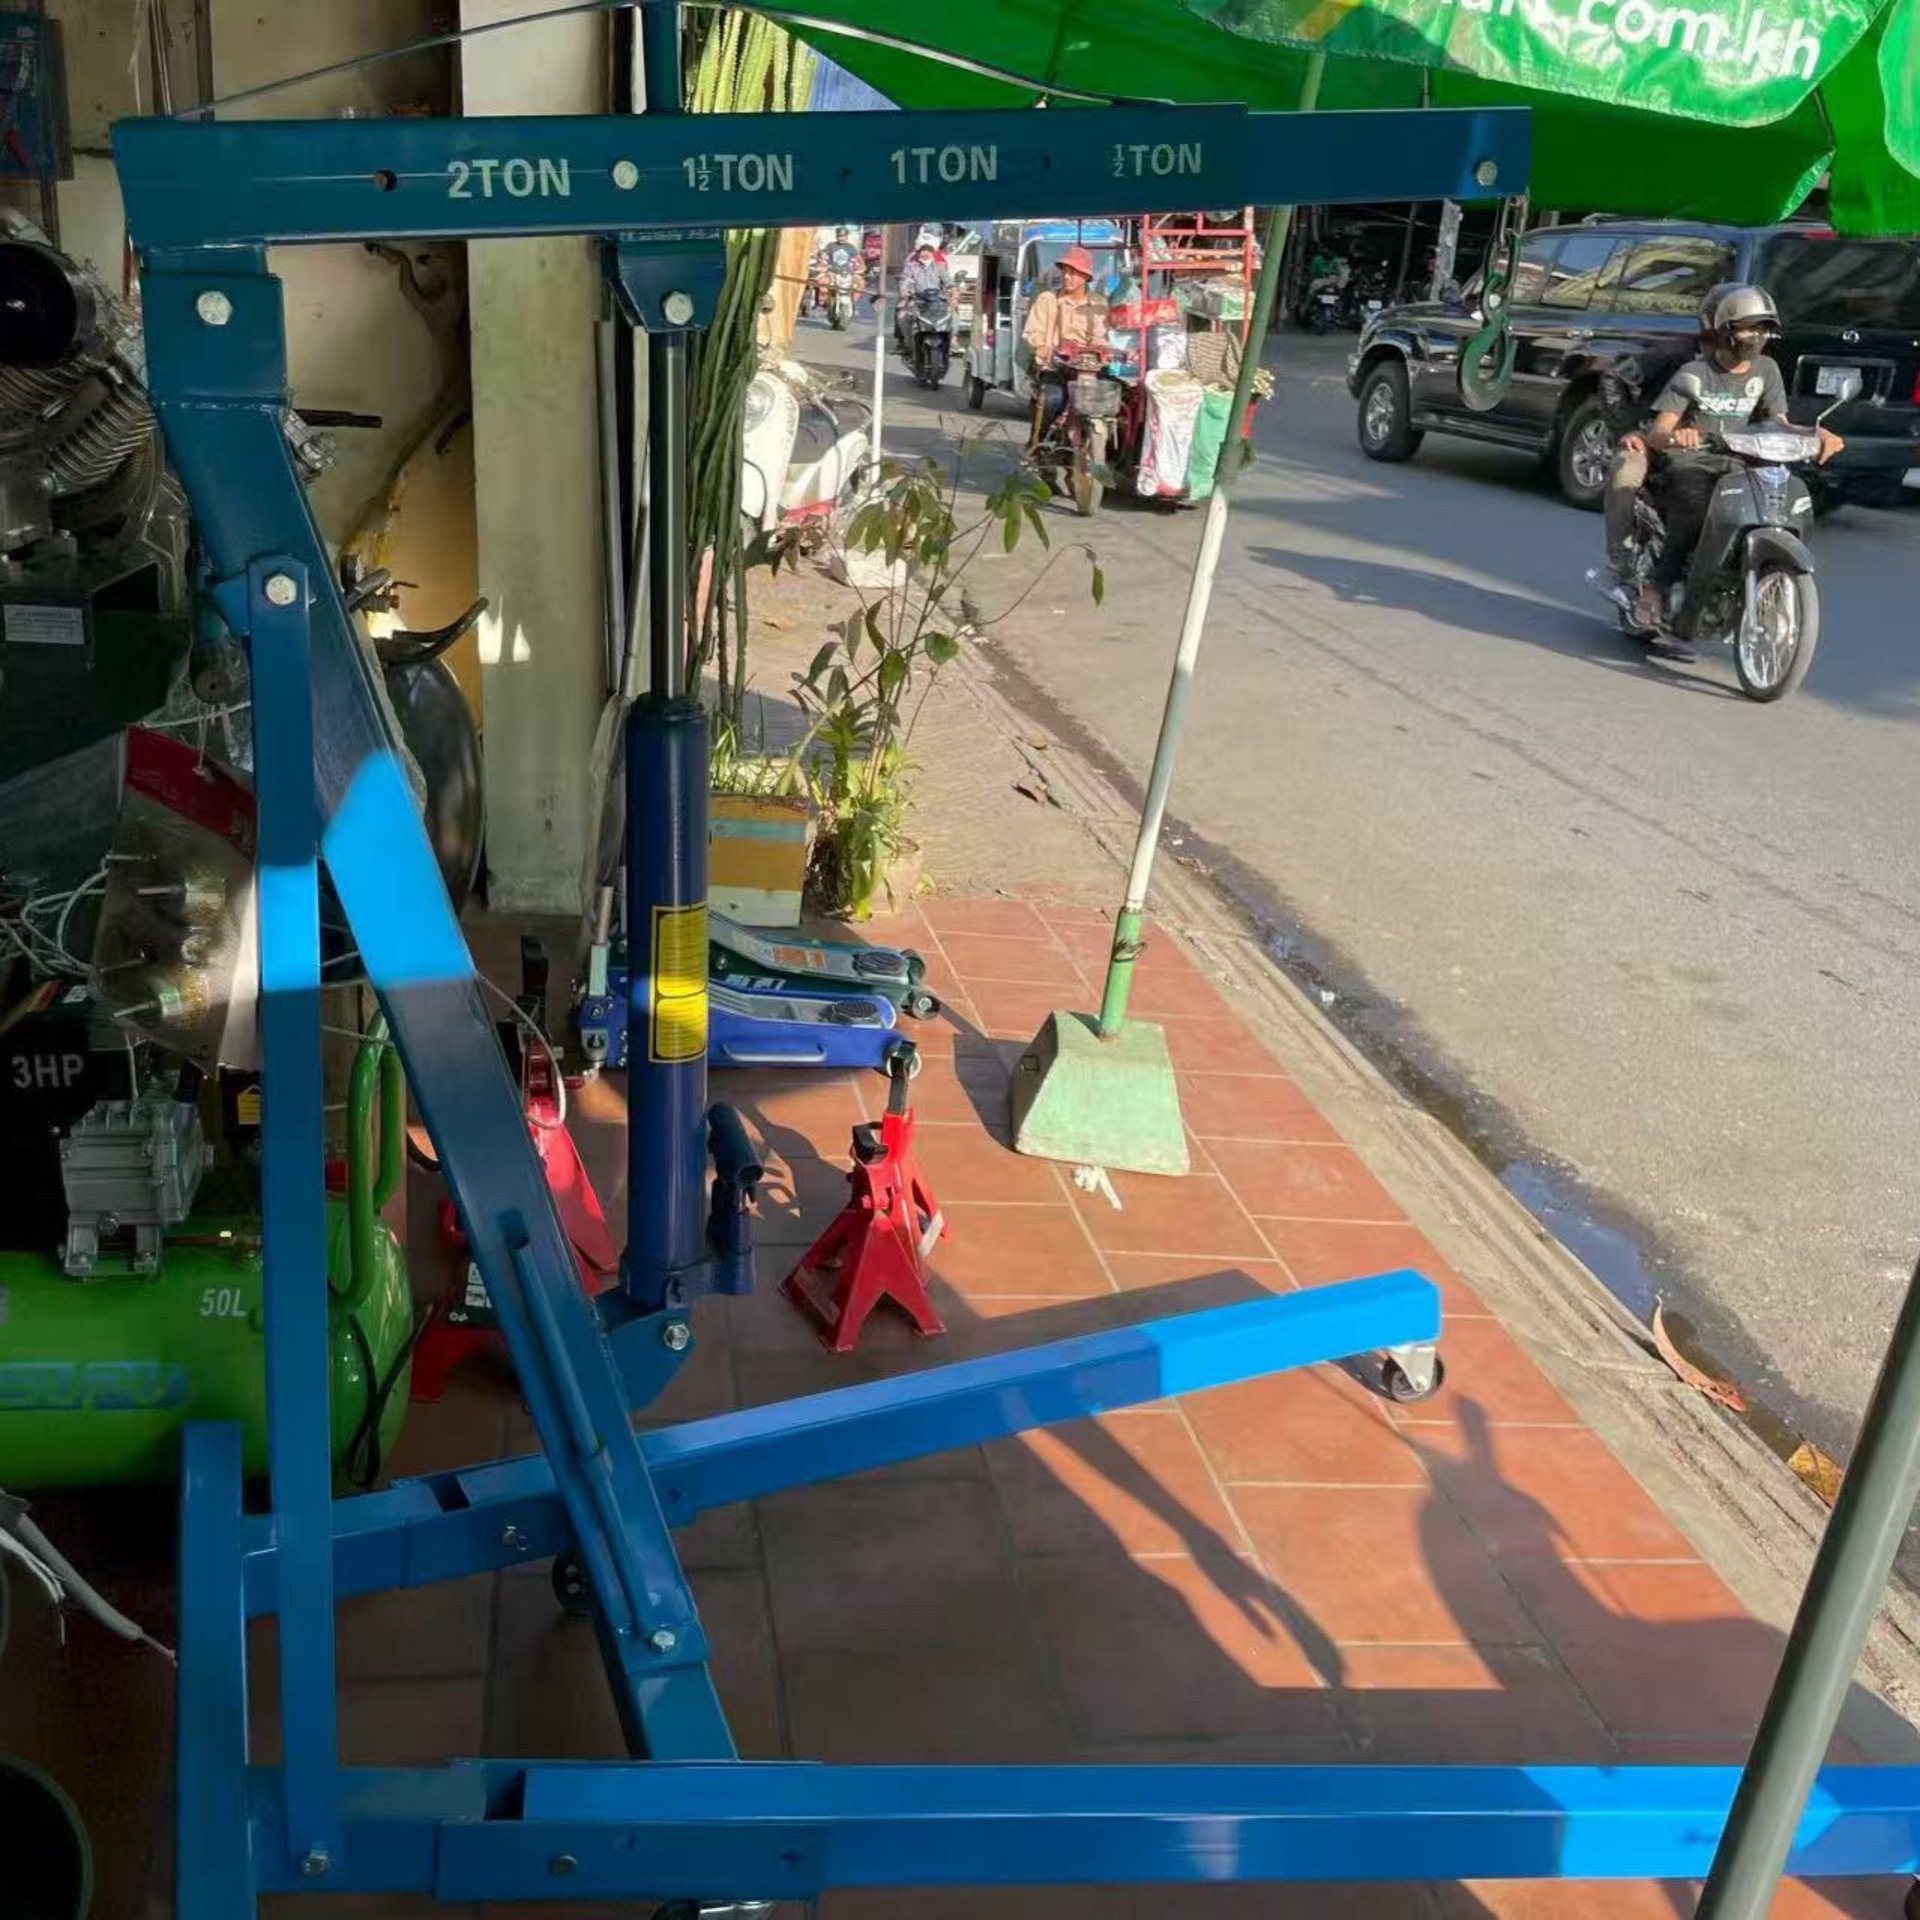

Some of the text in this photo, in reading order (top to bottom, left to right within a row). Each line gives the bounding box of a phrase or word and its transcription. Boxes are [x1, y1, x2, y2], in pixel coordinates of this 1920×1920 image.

[1440, 0, 1820, 80] .com.kh
[447, 158, 571, 198] 2TON
[891, 145, 997, 184] 1TON
[12, 1053, 85, 1088] 3HP
[200, 1288, 247, 1317] 50L
